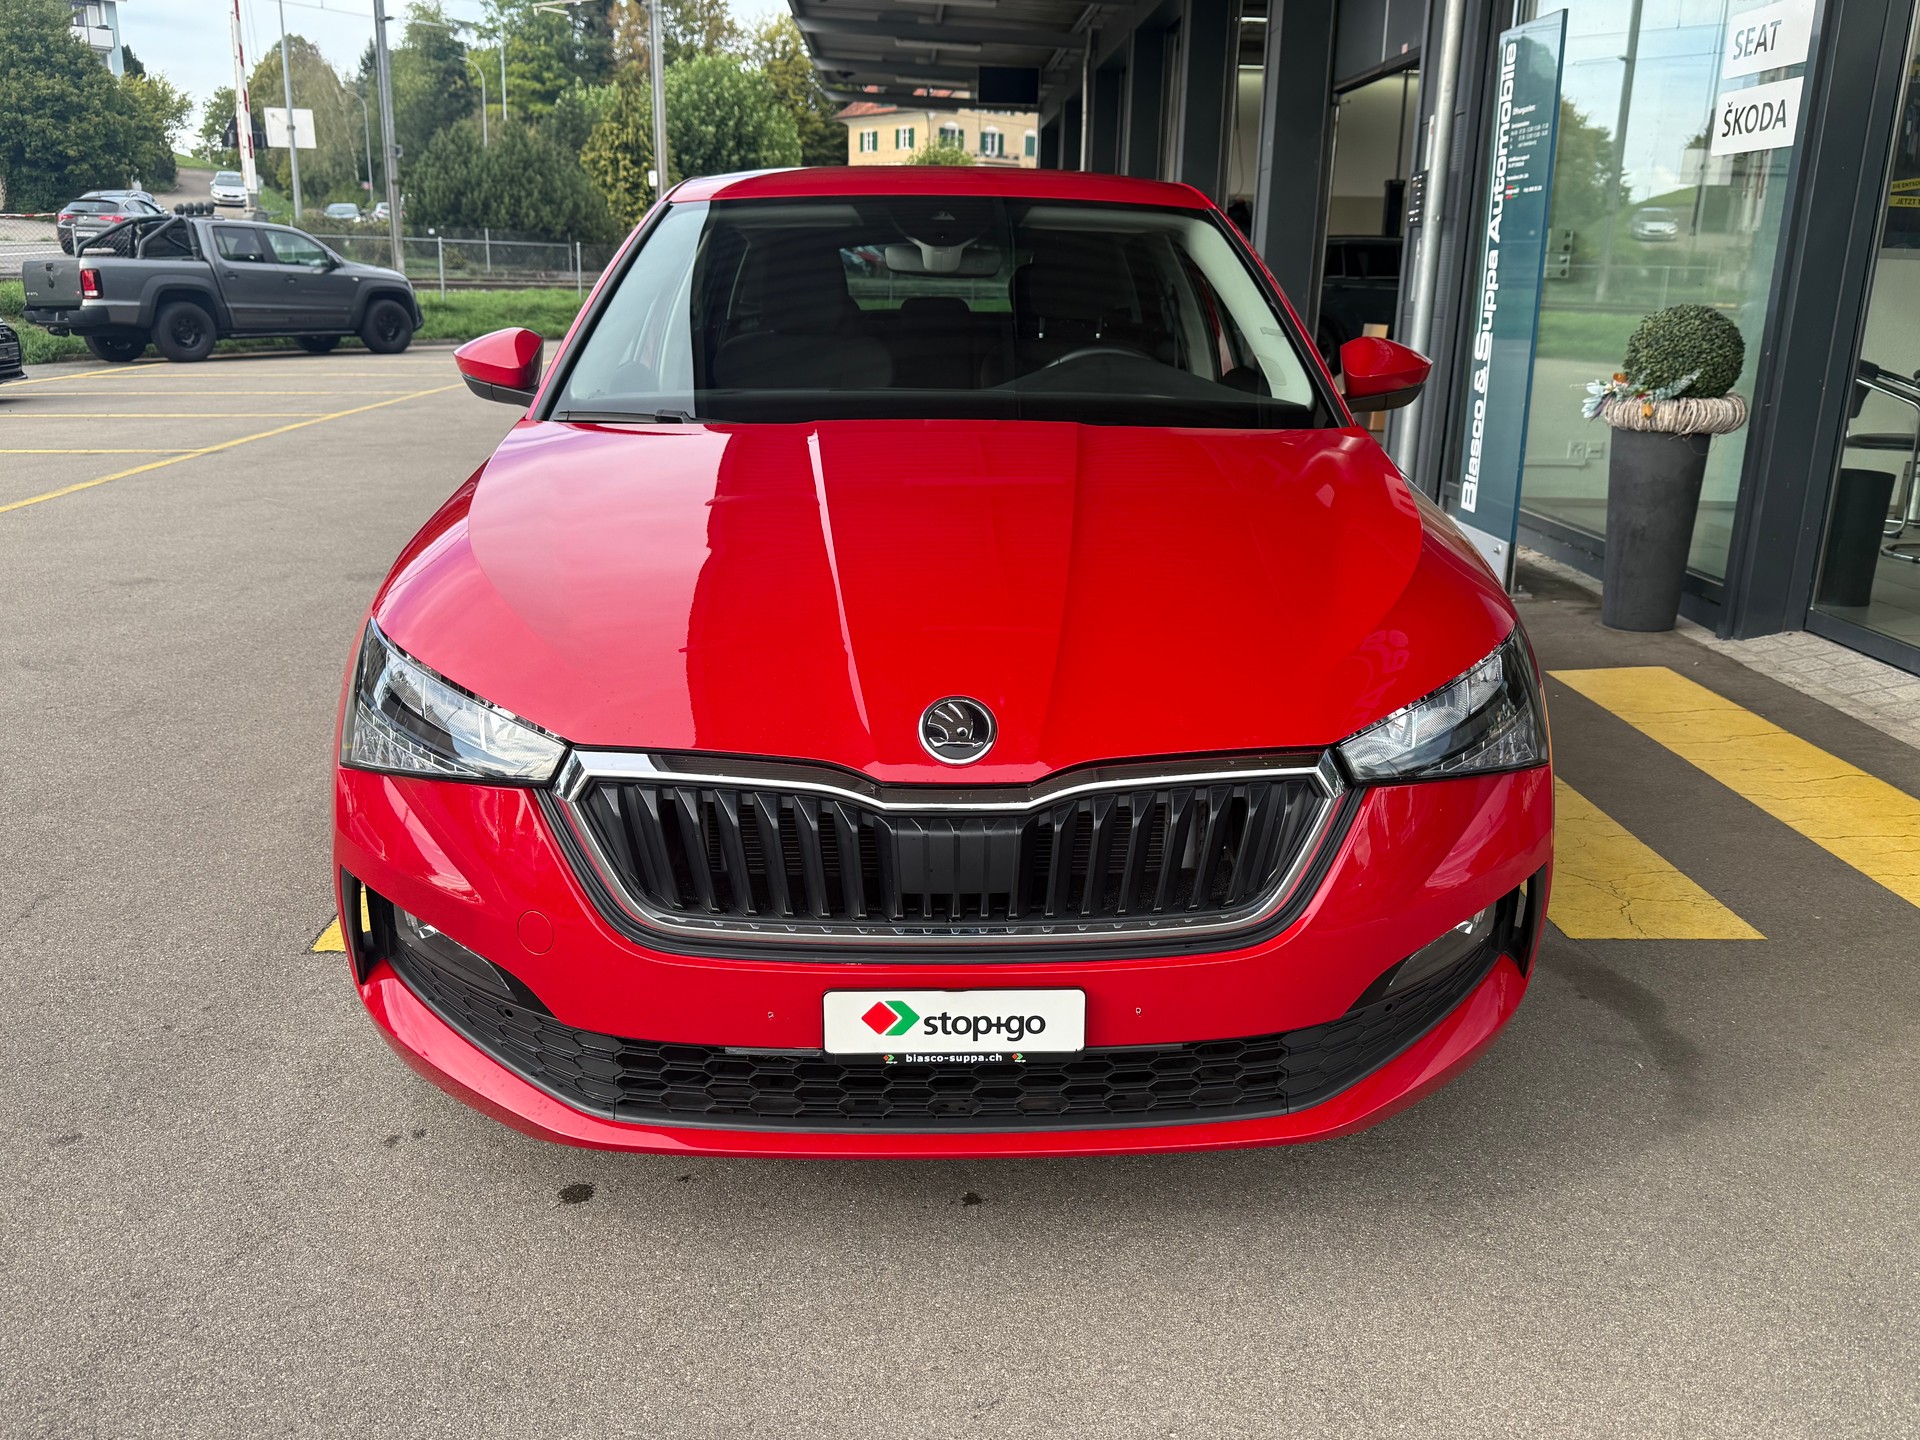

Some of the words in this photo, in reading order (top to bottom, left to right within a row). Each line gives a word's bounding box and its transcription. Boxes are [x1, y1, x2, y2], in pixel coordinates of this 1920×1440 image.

[1732, 19, 1782, 61] SEAT
[1721, 98, 1787, 138] ŠKODA
[1488, 42, 1517, 243] Automobile
[1895, 197, 1916, 206] JETZT
[1474, 249, 1499, 361] Suppa
[1473, 365, 1488, 394] &
[1461, 399, 1485, 513] Biasco
[923, 1011, 1046, 1042] stop+go
[905, 1053, 1003, 1064] biasco-suppa.ch
